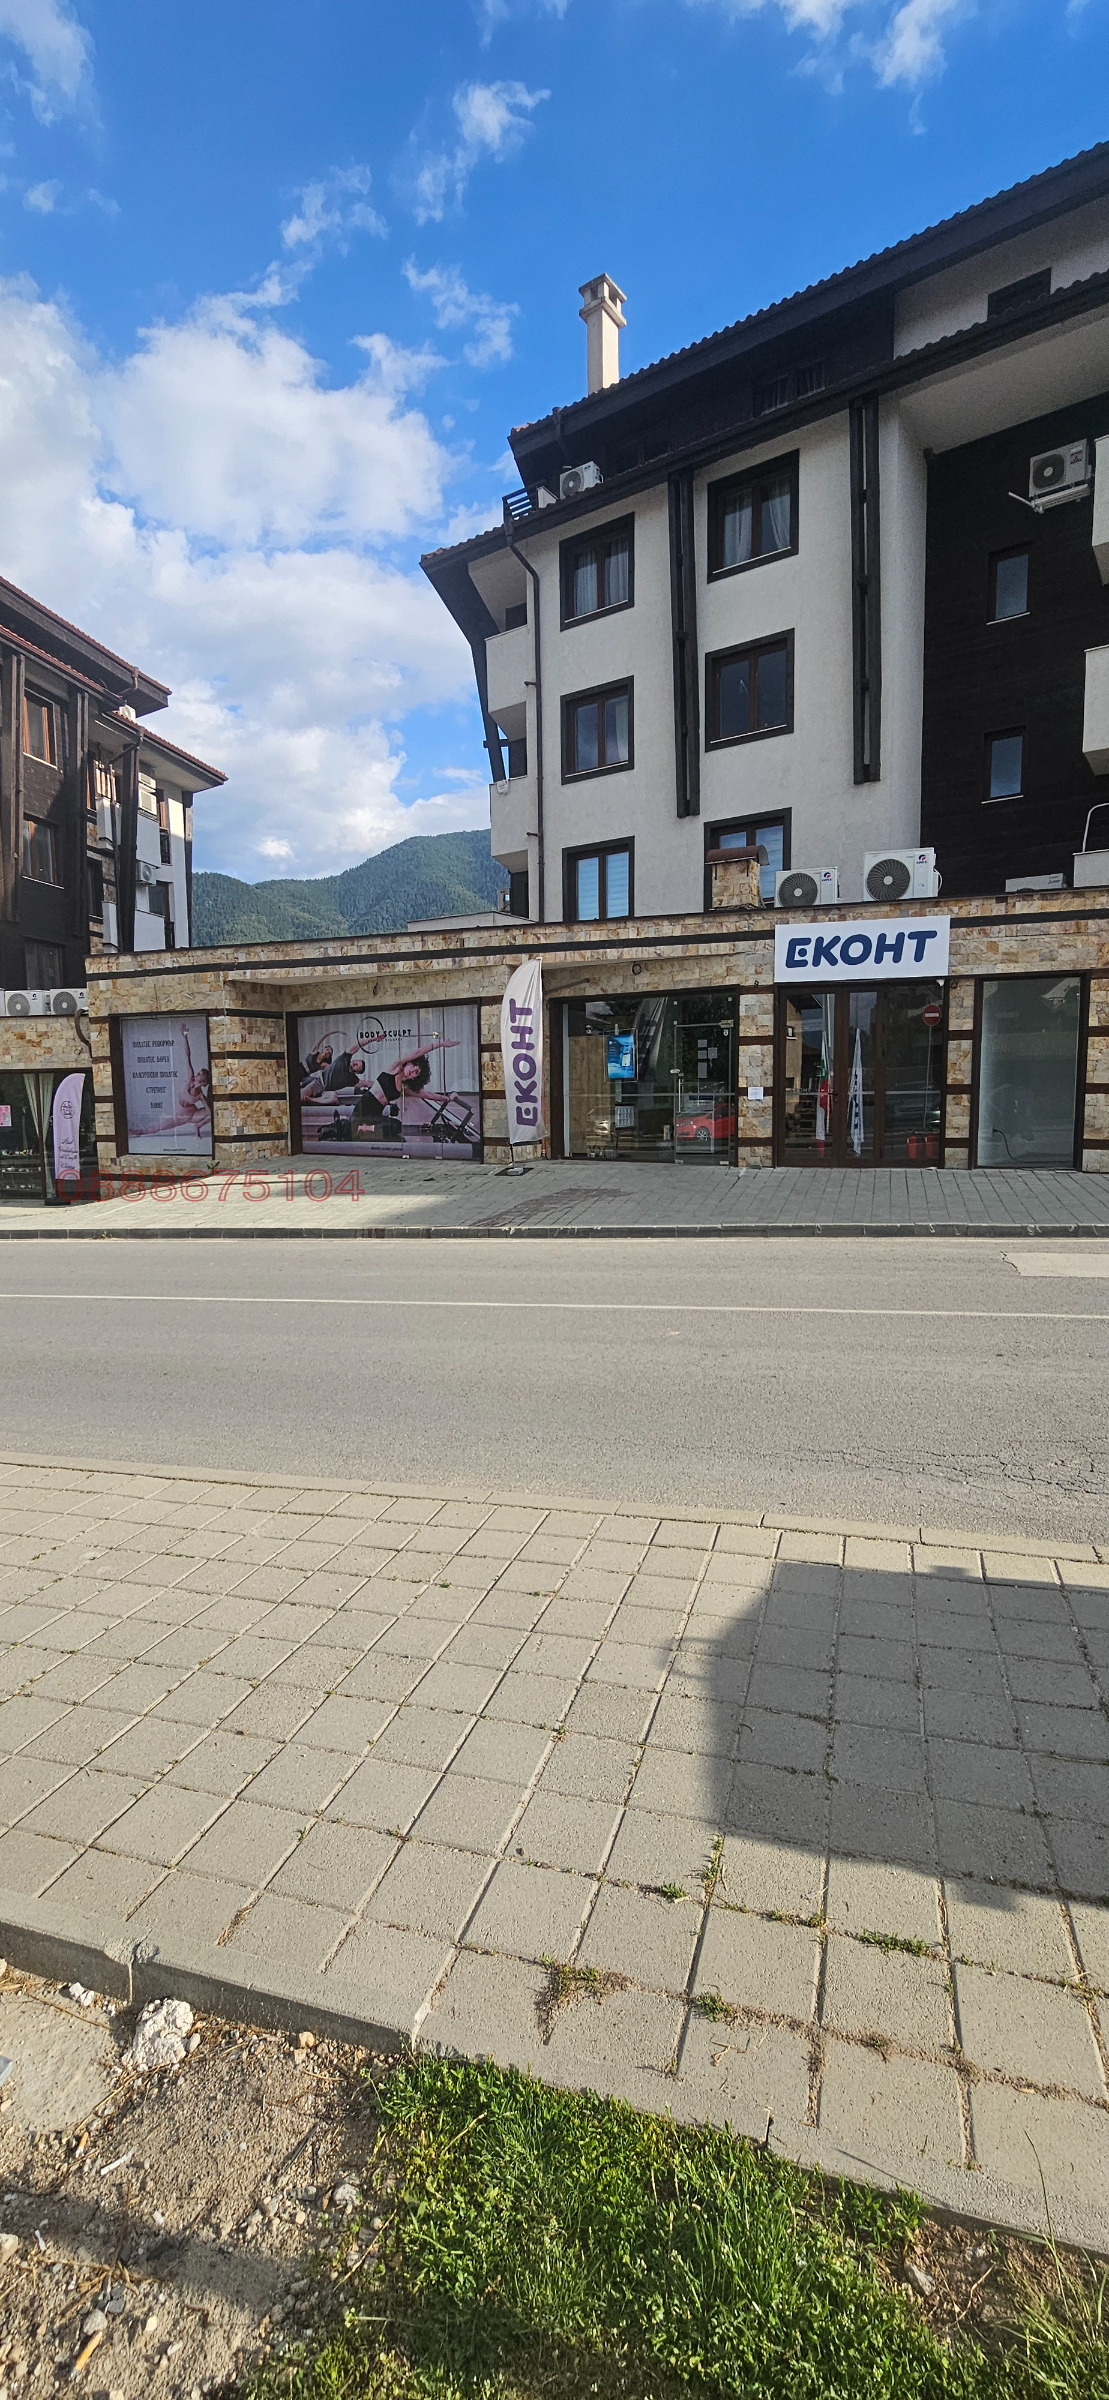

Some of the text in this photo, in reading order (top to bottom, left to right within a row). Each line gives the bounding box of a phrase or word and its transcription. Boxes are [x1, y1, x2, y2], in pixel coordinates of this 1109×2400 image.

[785, 930, 938, 969] ЕКОНТ
[384, 1029, 411, 1037] SCULPT
[509, 998, 538, 1126] ЕКОНТ
